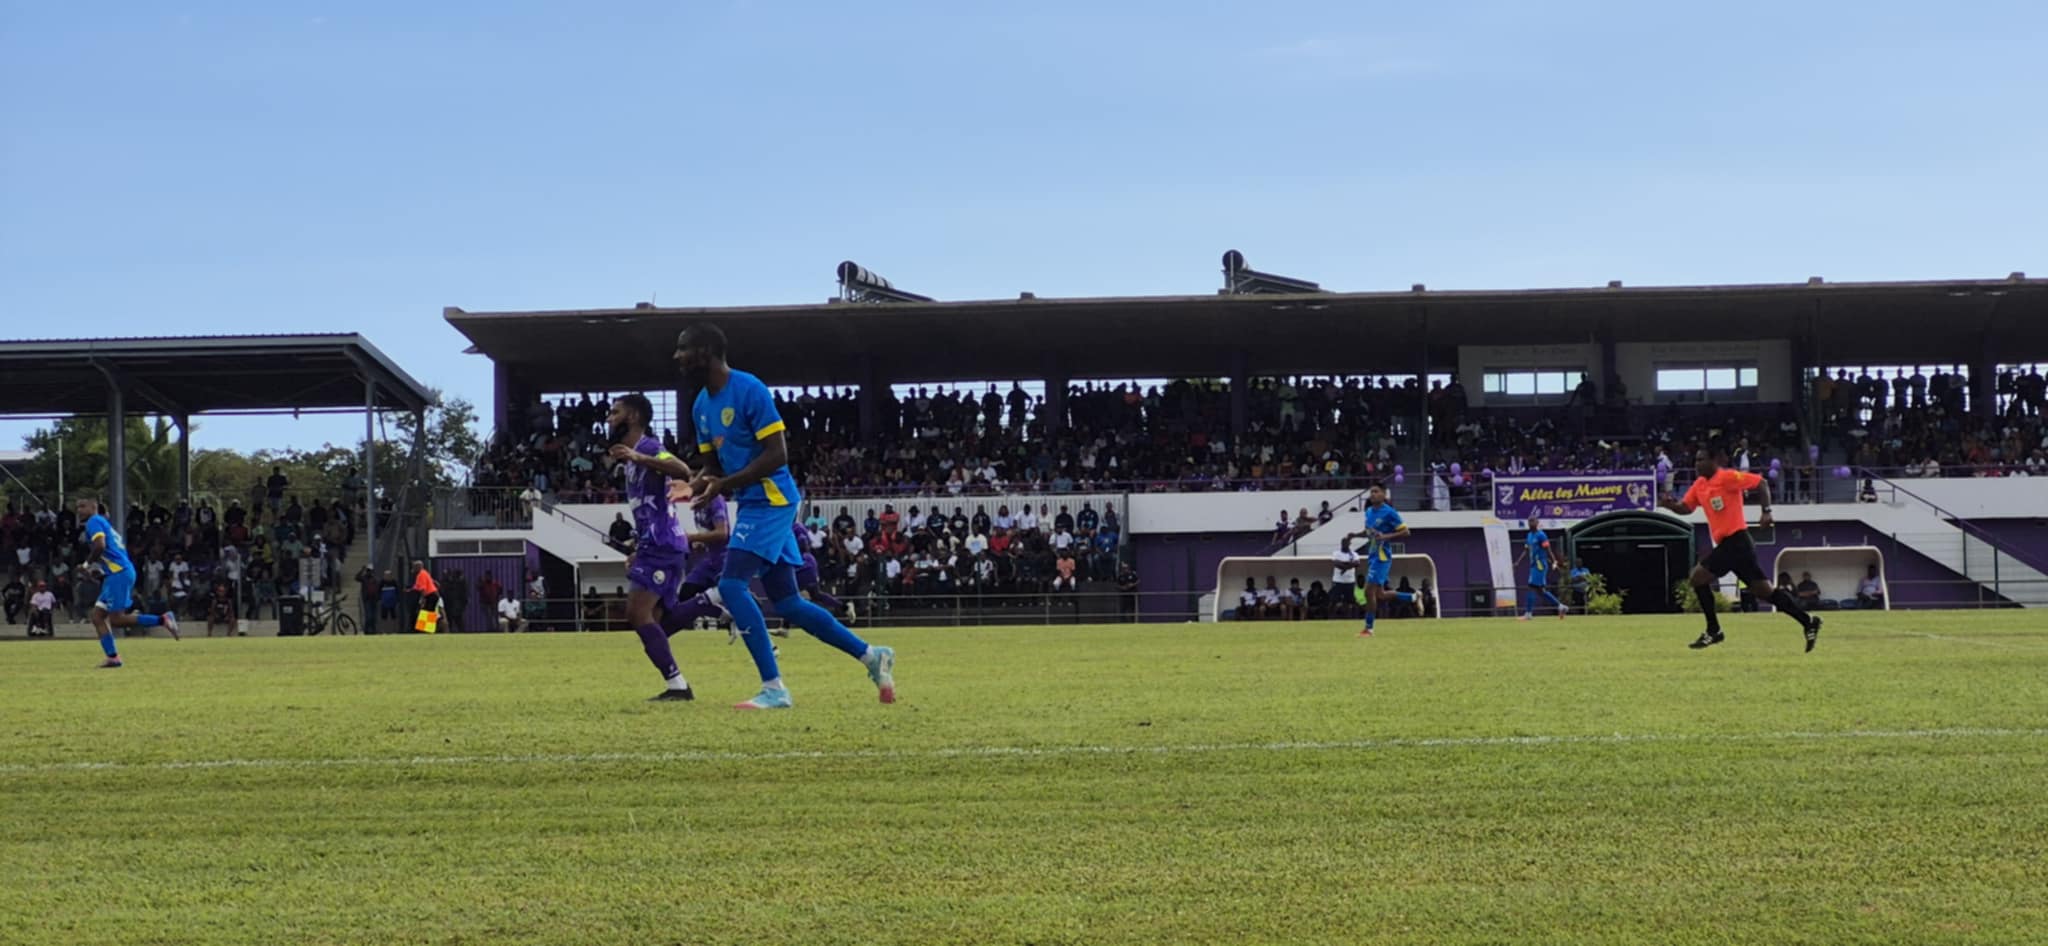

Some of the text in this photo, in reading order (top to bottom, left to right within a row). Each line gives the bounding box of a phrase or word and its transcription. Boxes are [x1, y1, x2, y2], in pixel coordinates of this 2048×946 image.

[1520, 483, 1623, 501] Allez les Mauves
